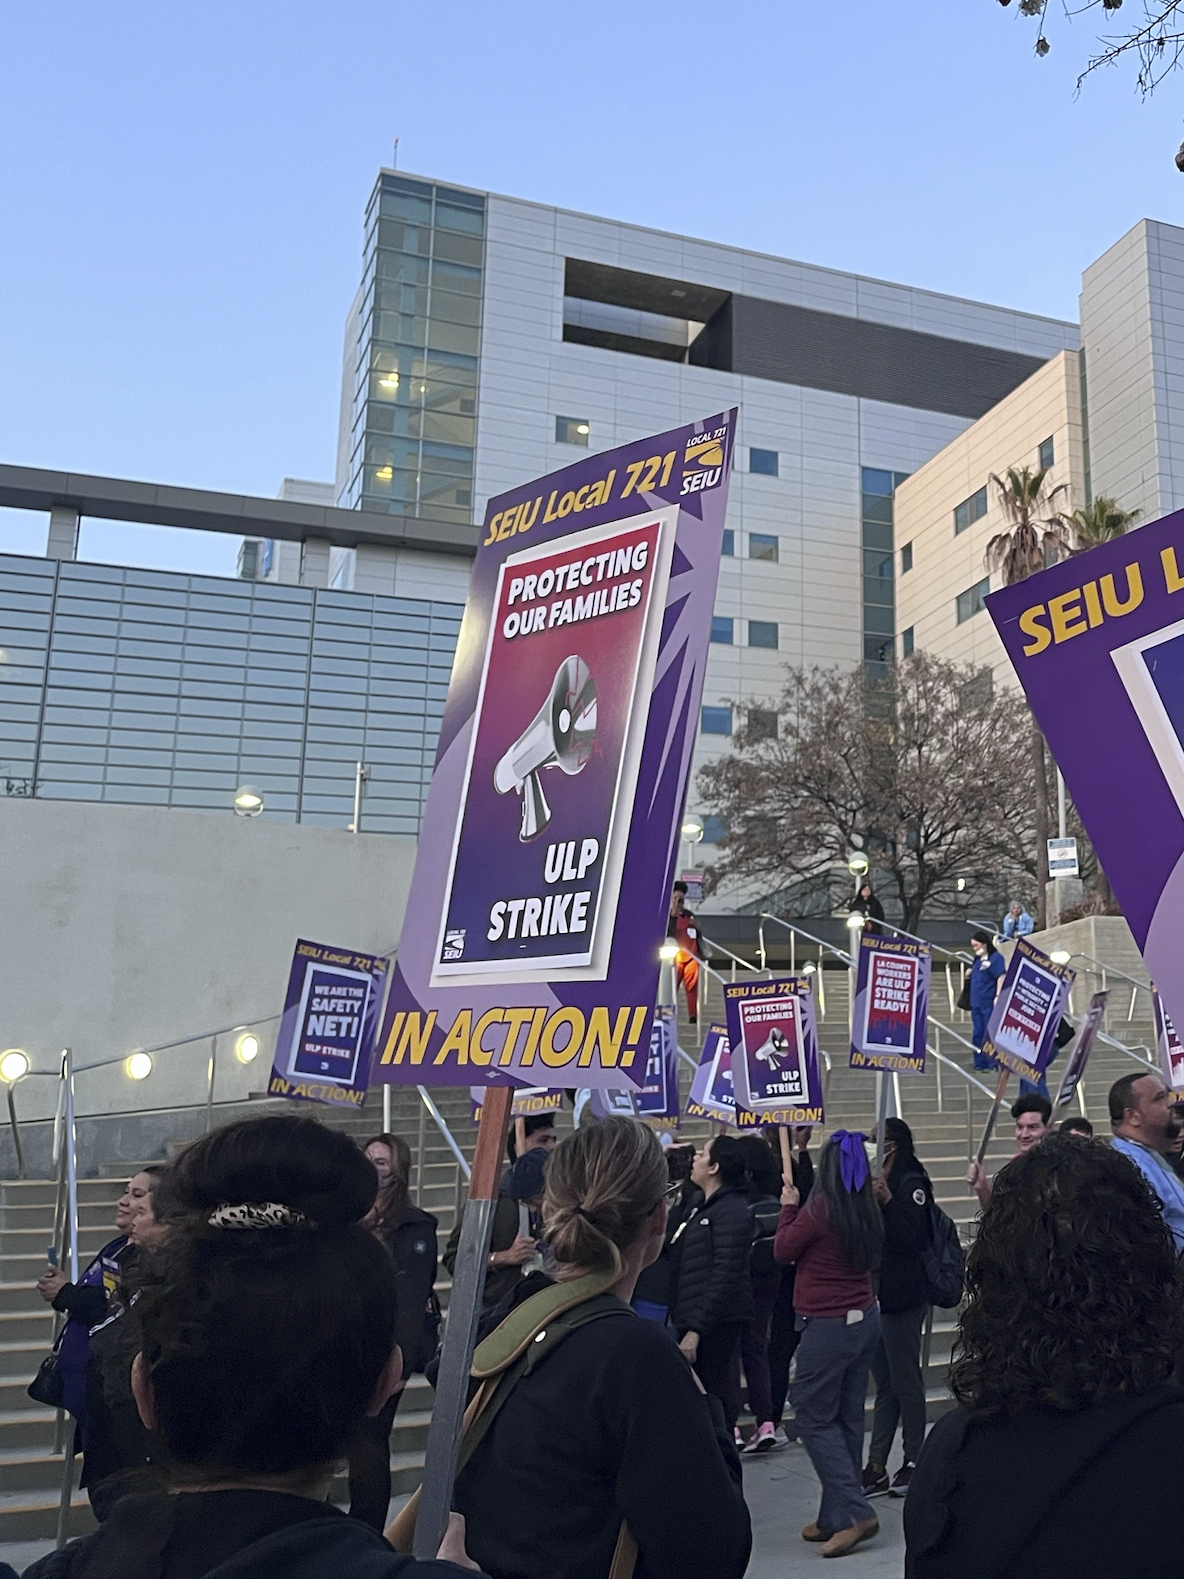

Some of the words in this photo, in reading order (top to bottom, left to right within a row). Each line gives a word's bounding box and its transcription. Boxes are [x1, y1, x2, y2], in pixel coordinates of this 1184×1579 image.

[687, 432, 711, 448] LOCAL
[713, 426, 727, 438] 721
[680, 466, 721, 496] SEIU
[483, 497, 542, 547] SEIU
[543, 470, 616, 524] Local
[620, 449, 677, 500] 721
[507, 541, 648, 606] PROTECTING
[503, 603, 545, 639] OUR
[548, 579, 643, 629] FAMILIES
[1017, 561, 1145, 658] SEIU
[544, 838, 600, 884] ULP
[487, 890, 591, 942] STRIKE
[902, 943, 918, 954] 721
[353, 956, 372, 969] 721
[877, 960, 886, 968] LA
[726, 987, 749, 998] SEIU
[751, 984, 776, 996] Local
[778, 983, 795, 993] 721
[876, 977, 894, 987] ARE
[895, 978, 911, 990] ULP
[875, 987, 910, 1002] STRIKE
[311, 997, 362, 1015] SAFETY
[744, 1002, 792, 1015] PROTECTING
[873, 999, 909, 1013] READY!
[745, 1014, 762, 1023] OUR
[762, 1011, 793, 1021] FAMILIES
[306, 1015, 360, 1038] NET!
[379, 1010, 439, 1066] IN
[433, 1006, 649, 1069] ACTION!
[305, 1043, 321, 1053] ULP
[322, 1045, 351, 1059] STRIKE
[851, 1053, 866, 1065] IN
[867, 1055, 924, 1071] ACTION!
[982, 1041, 994, 1057] IN
[995, 1052, 1042, 1083] ACTION!
[781, 1071, 799, 1081] ULP
[270, 1078, 290, 1094] IN
[292, 1083, 365, 1105] ACTION!
[766, 1082, 801, 1094] STRIKE
[516, 1093, 561, 1113] TION!
[688, 1104, 706, 1115] IN
[738, 1111, 756, 1125] IN
[759, 1107, 823, 1124] ACTION!
